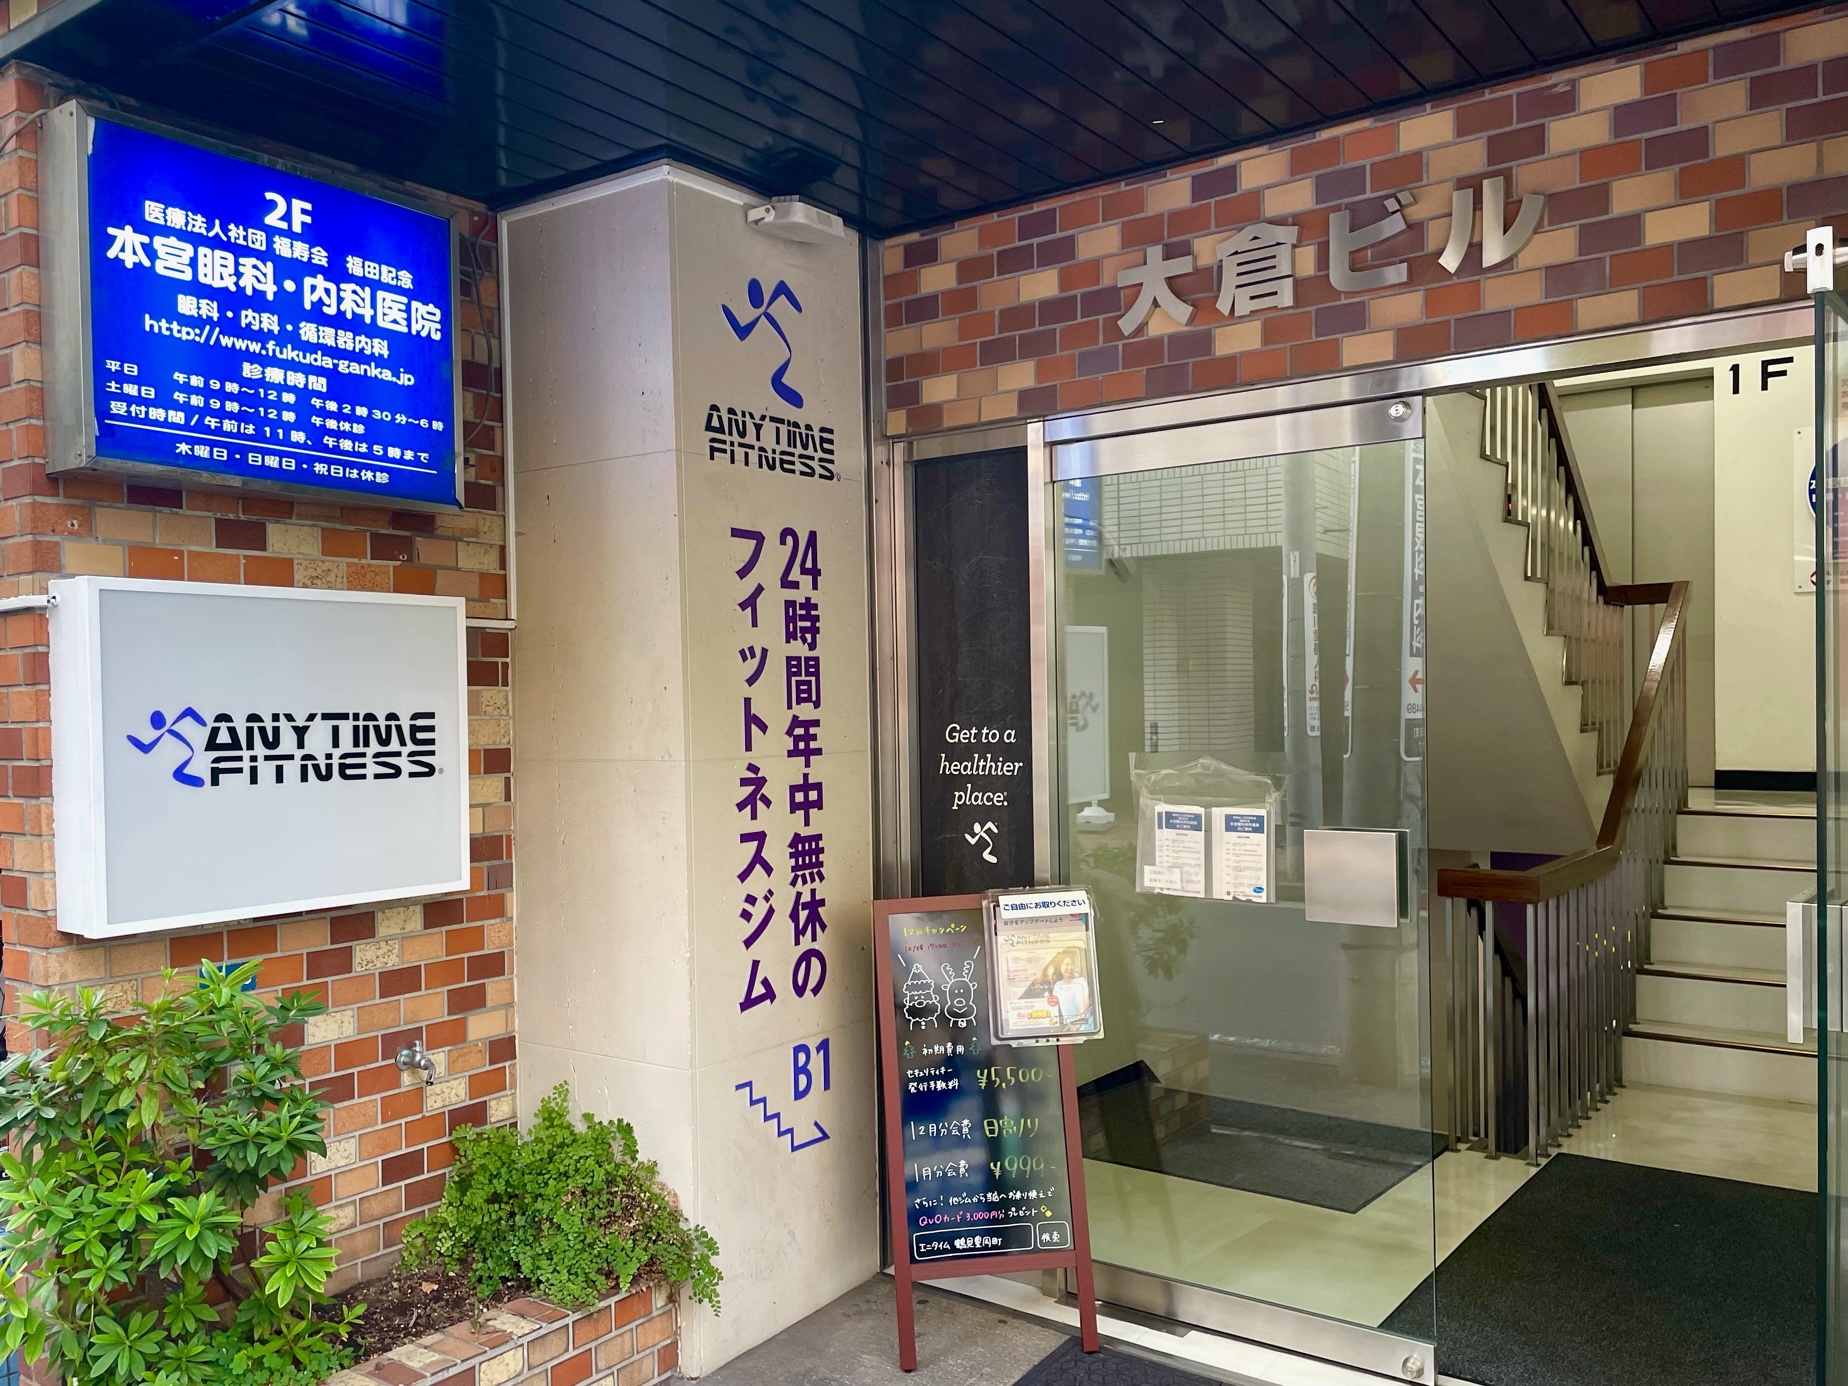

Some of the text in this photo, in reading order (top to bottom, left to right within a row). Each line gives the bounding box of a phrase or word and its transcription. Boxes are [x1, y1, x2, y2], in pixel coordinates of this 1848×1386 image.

[264, 192, 312, 234] 2F
[145, 200, 413, 289] 医療法人社団 福寿会 福田記念
[1117, 176, 1546, 337] 大倉ビル
[107, 225, 442, 341] 本宮眼科・内科医院
[178, 294, 389, 358] 眼科・内科・循環器内科
[105, 360, 138, 376] 平日
[144, 313, 415, 386] http://www.fukuda-ganka.jp
[242, 362, 327, 392] 診療時間
[1728, 356, 1794, 395] 1F
[105, 381, 155, 399] 土曜日
[311, 415, 366, 434] 午後休診
[705, 404, 835, 455] ANYTIME
[175, 443, 390, 484] 木曜日・日曜日・祝日は休診
[204, 711, 436, 752] ANYTIME
[945, 723, 1017, 744] Get to a
[730, 527, 777, 1014] フィットネスジム
[779, 527, 827, 998] 24時間年中無休の
[939, 753, 1023, 776] healthier
[1003, 899, 1086, 912] ご自由にお取りください
[792, 1037, 831, 1101] B1
[922, 1041, 965, 1057] 初期費用
[906, 1066, 953, 1079] セキュリティキー
[908, 1078, 959, 1094] 発行手数料
[910, 1115, 1039, 1140] 12月分会費 日割り
[914, 1160, 969, 1183] 1月分会費
[1008, 1206, 1038, 1218] プレゼント
[918, 1232, 1061, 1253] エニタイム 鶴見豊岡町 検索
